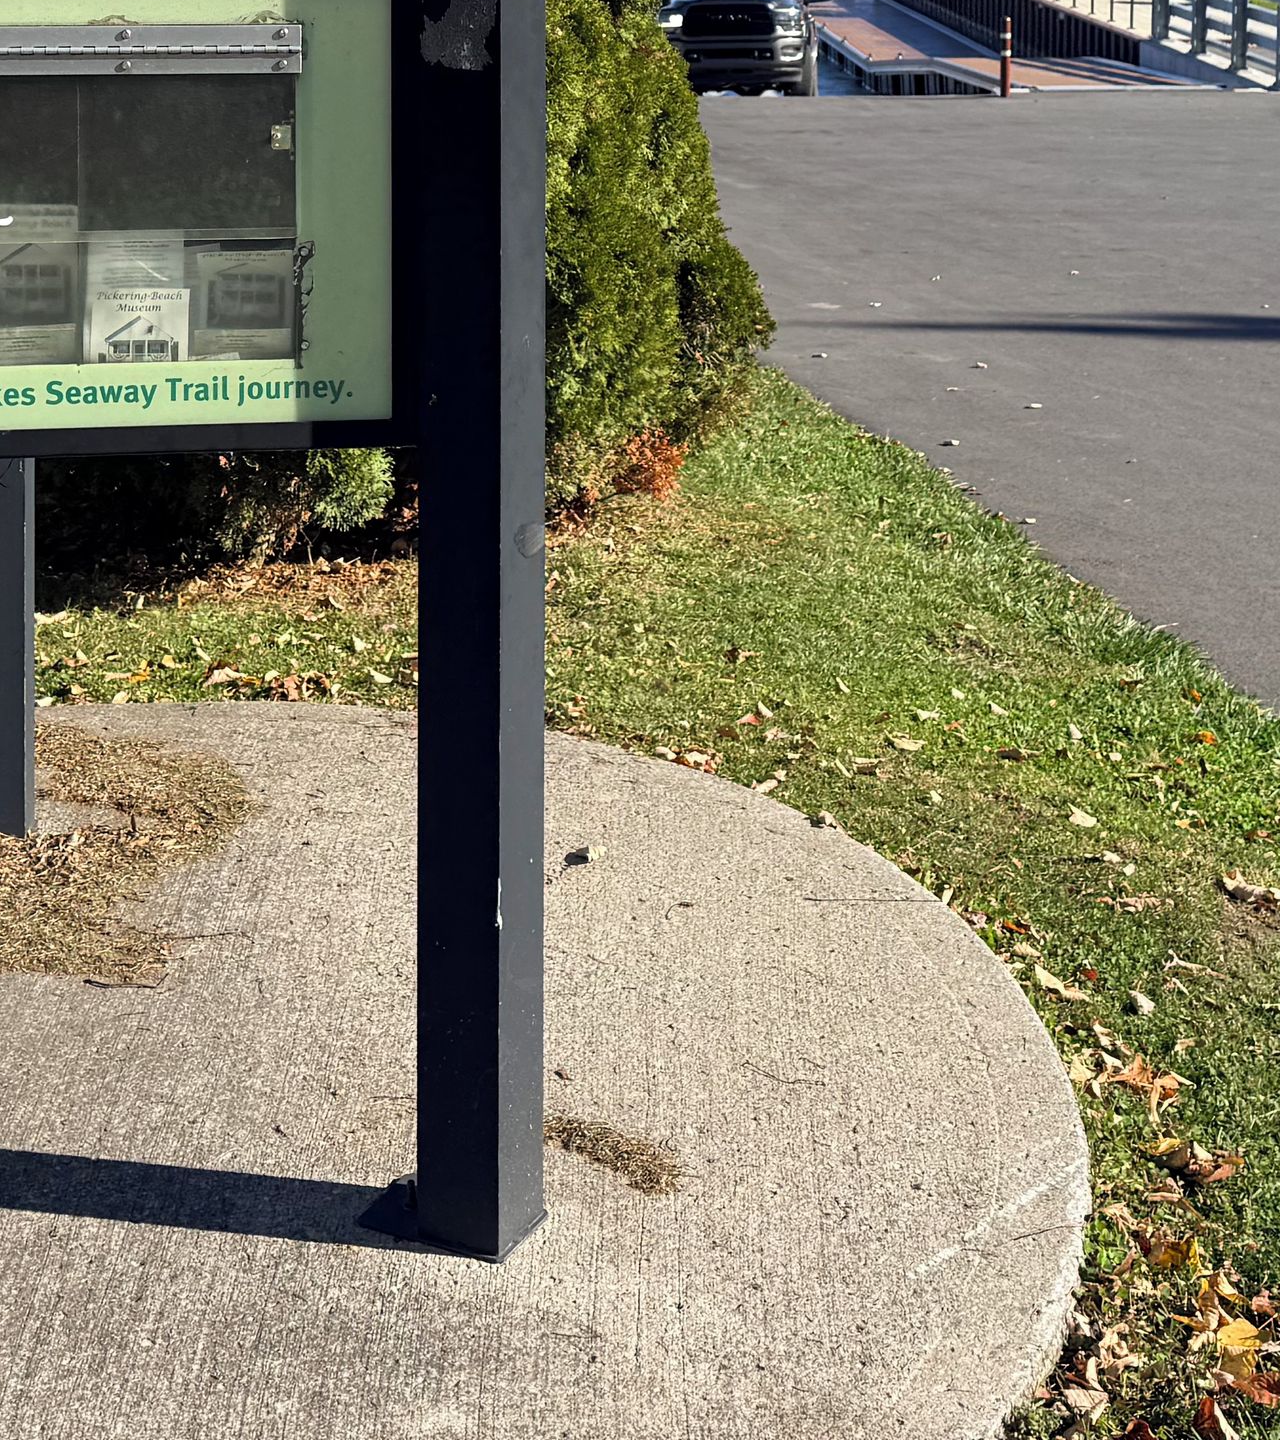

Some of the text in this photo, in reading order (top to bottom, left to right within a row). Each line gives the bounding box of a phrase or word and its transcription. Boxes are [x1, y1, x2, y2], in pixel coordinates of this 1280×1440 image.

[116, 303, 162, 312] Museum
[45, 380, 158, 410] Seaway
[165, 375, 230, 402] Trail
[237, 375, 354, 407] journey.
